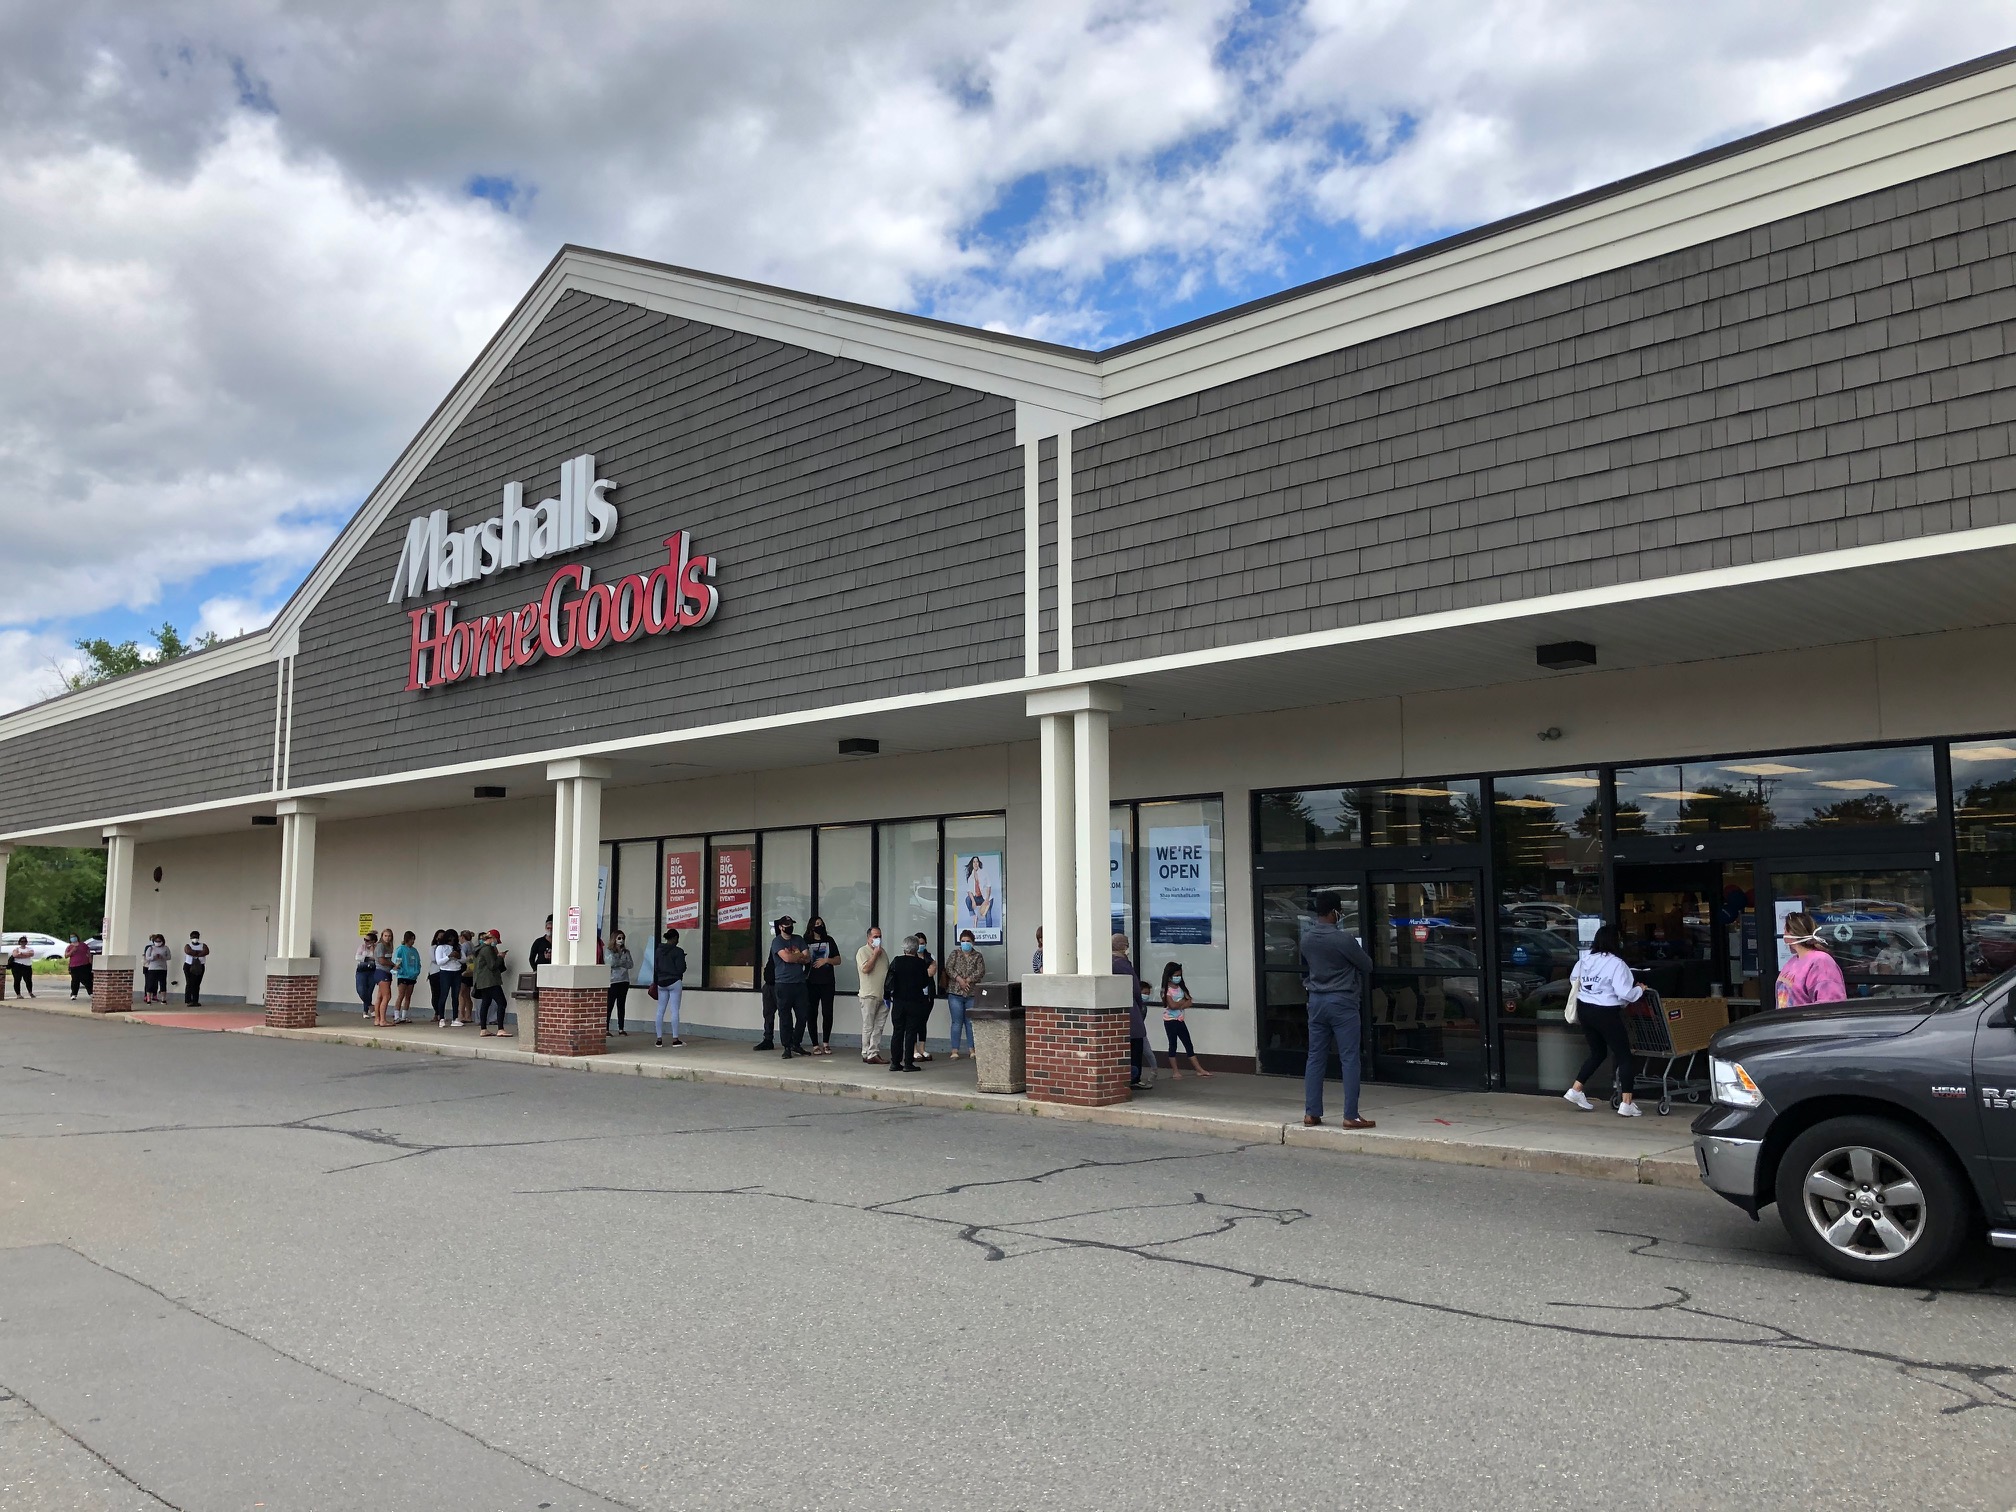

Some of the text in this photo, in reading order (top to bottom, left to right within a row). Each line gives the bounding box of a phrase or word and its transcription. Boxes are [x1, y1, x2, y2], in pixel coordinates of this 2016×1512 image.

[387, 453, 619, 603] Marshalls
[404, 530, 719, 691] HomeGoods
[1156, 845, 1203, 861] WE'RE
[670, 857, 680, 865] BIG
[720, 856, 730, 864] BIG
[670, 865, 683, 875] BIG
[720, 864, 734, 874] BIG
[1159, 864, 1200, 879] OPEN
[670, 875, 687, 888] BIG
[720, 874, 737, 887] BIG
[1931, 1086, 1966, 1094] HEMI
